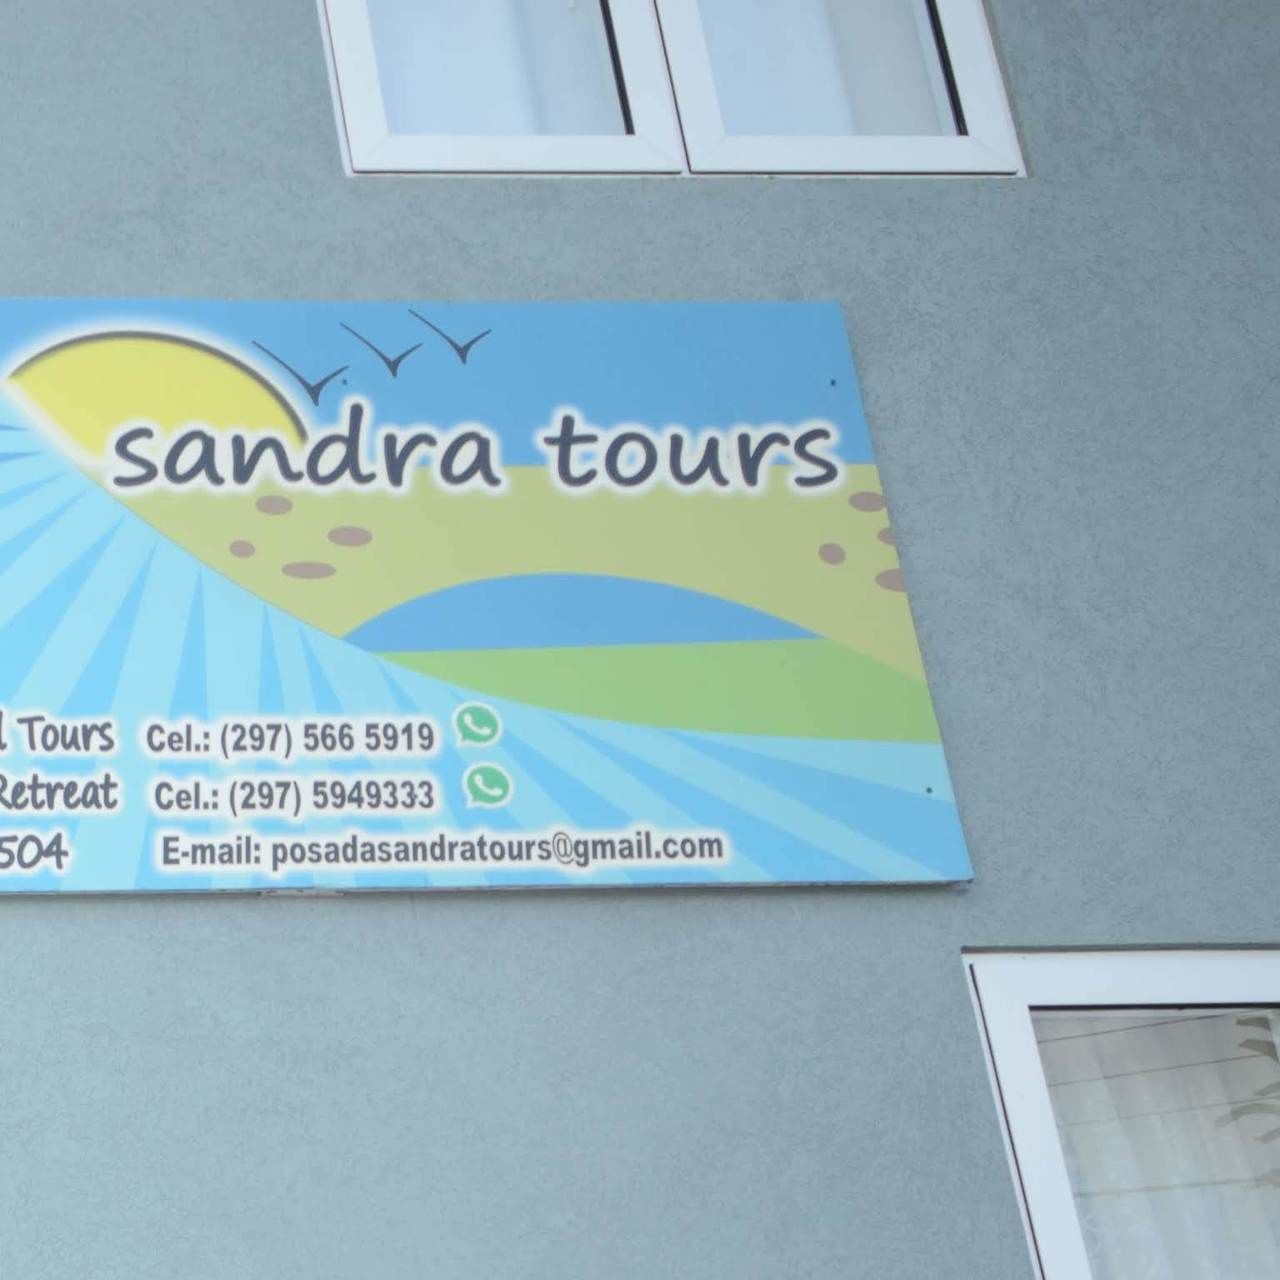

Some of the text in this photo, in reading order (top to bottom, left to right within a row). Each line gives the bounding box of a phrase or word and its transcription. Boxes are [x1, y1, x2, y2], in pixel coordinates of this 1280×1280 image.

[113, 402, 839, 488] sandra tours
[16, 716, 115, 752] Tours
[147, 723, 434, 759] Cel.: (297) 566 5919
[155, 780, 434, 817] Cel.: (297) 5949333
[163, 830, 723, 872] E-mail: posadasandratours@gmail.com
